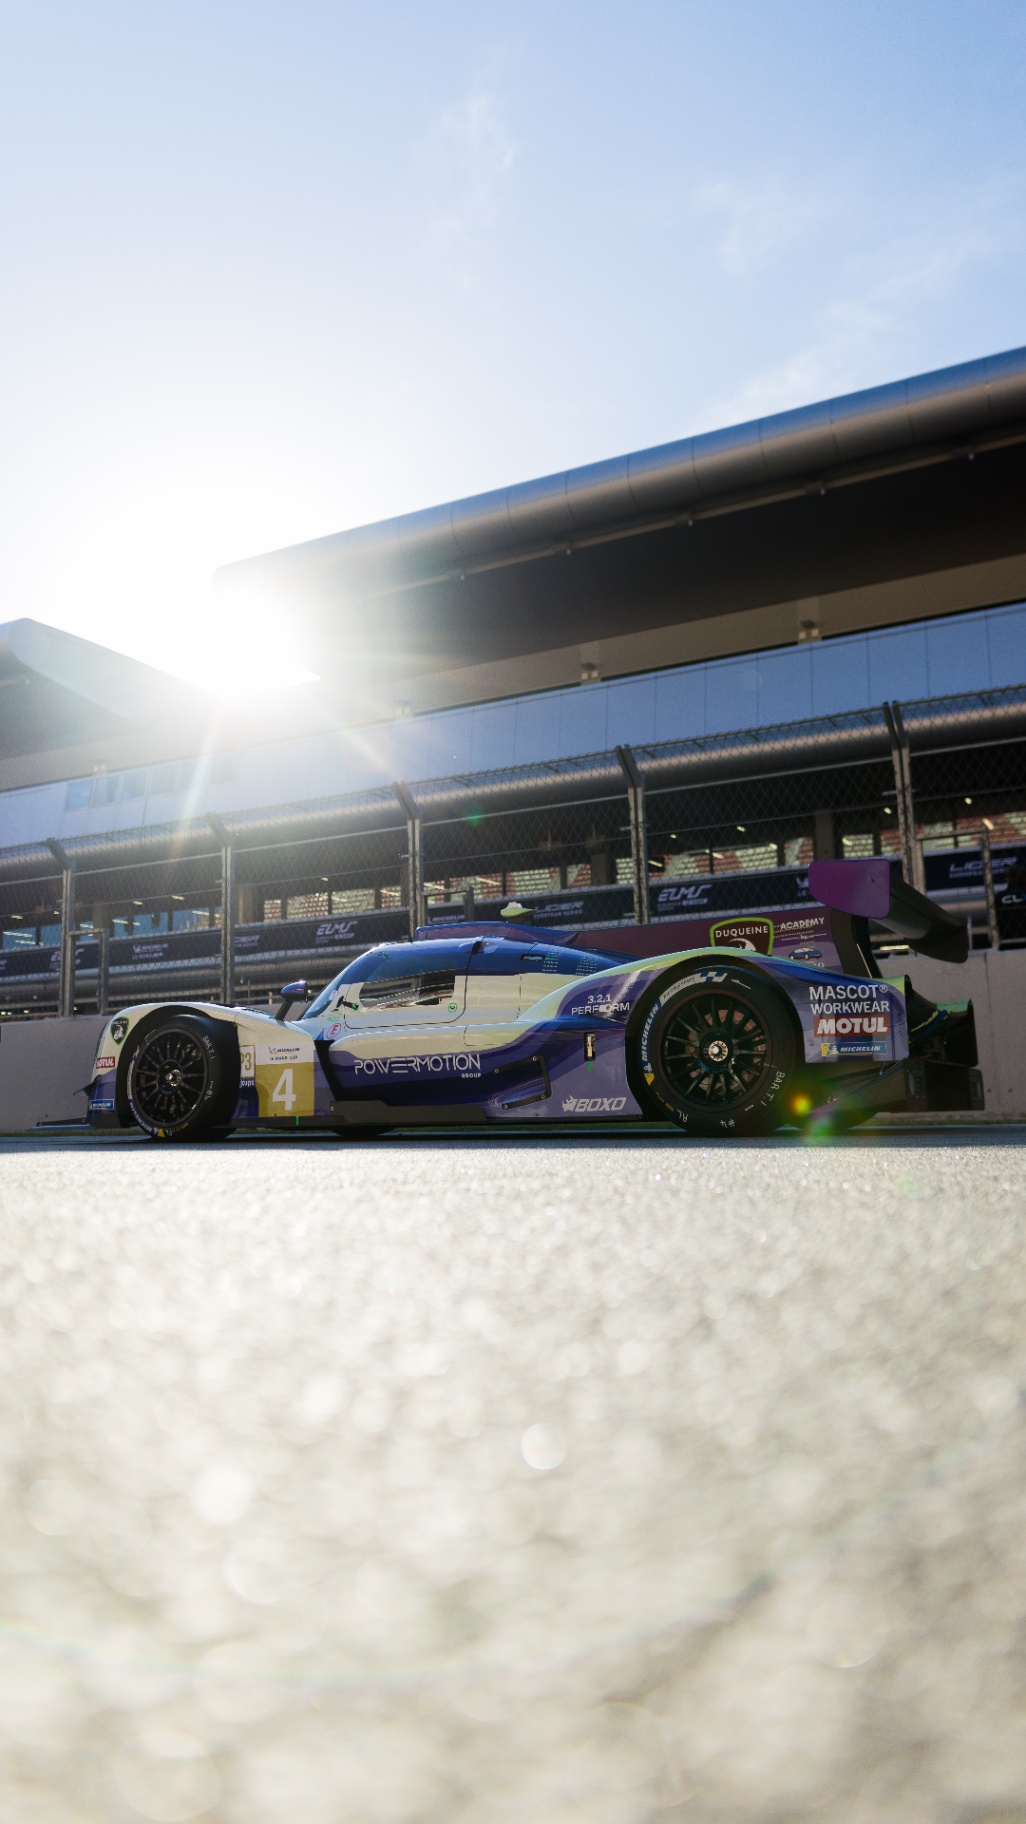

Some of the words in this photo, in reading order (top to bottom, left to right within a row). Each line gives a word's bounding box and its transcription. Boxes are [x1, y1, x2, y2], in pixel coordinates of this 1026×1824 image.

[781, 917, 825, 931] ACADEMY
[715, 925, 768, 938] DUQUEINE
[587, 994, 612, 1004] 3.2.1
[571, 1002, 630, 1015] PERFORM
[810, 1001, 890, 1015] WORKWEAR
[641, 1003, 659, 1062] MICHELIN
[816, 1017, 888, 1034] MOTUL
[354, 1054, 481, 1076] POWERMOTION
[272, 1068, 297, 1111] 4
[573, 1097, 627, 1112] BOXO
